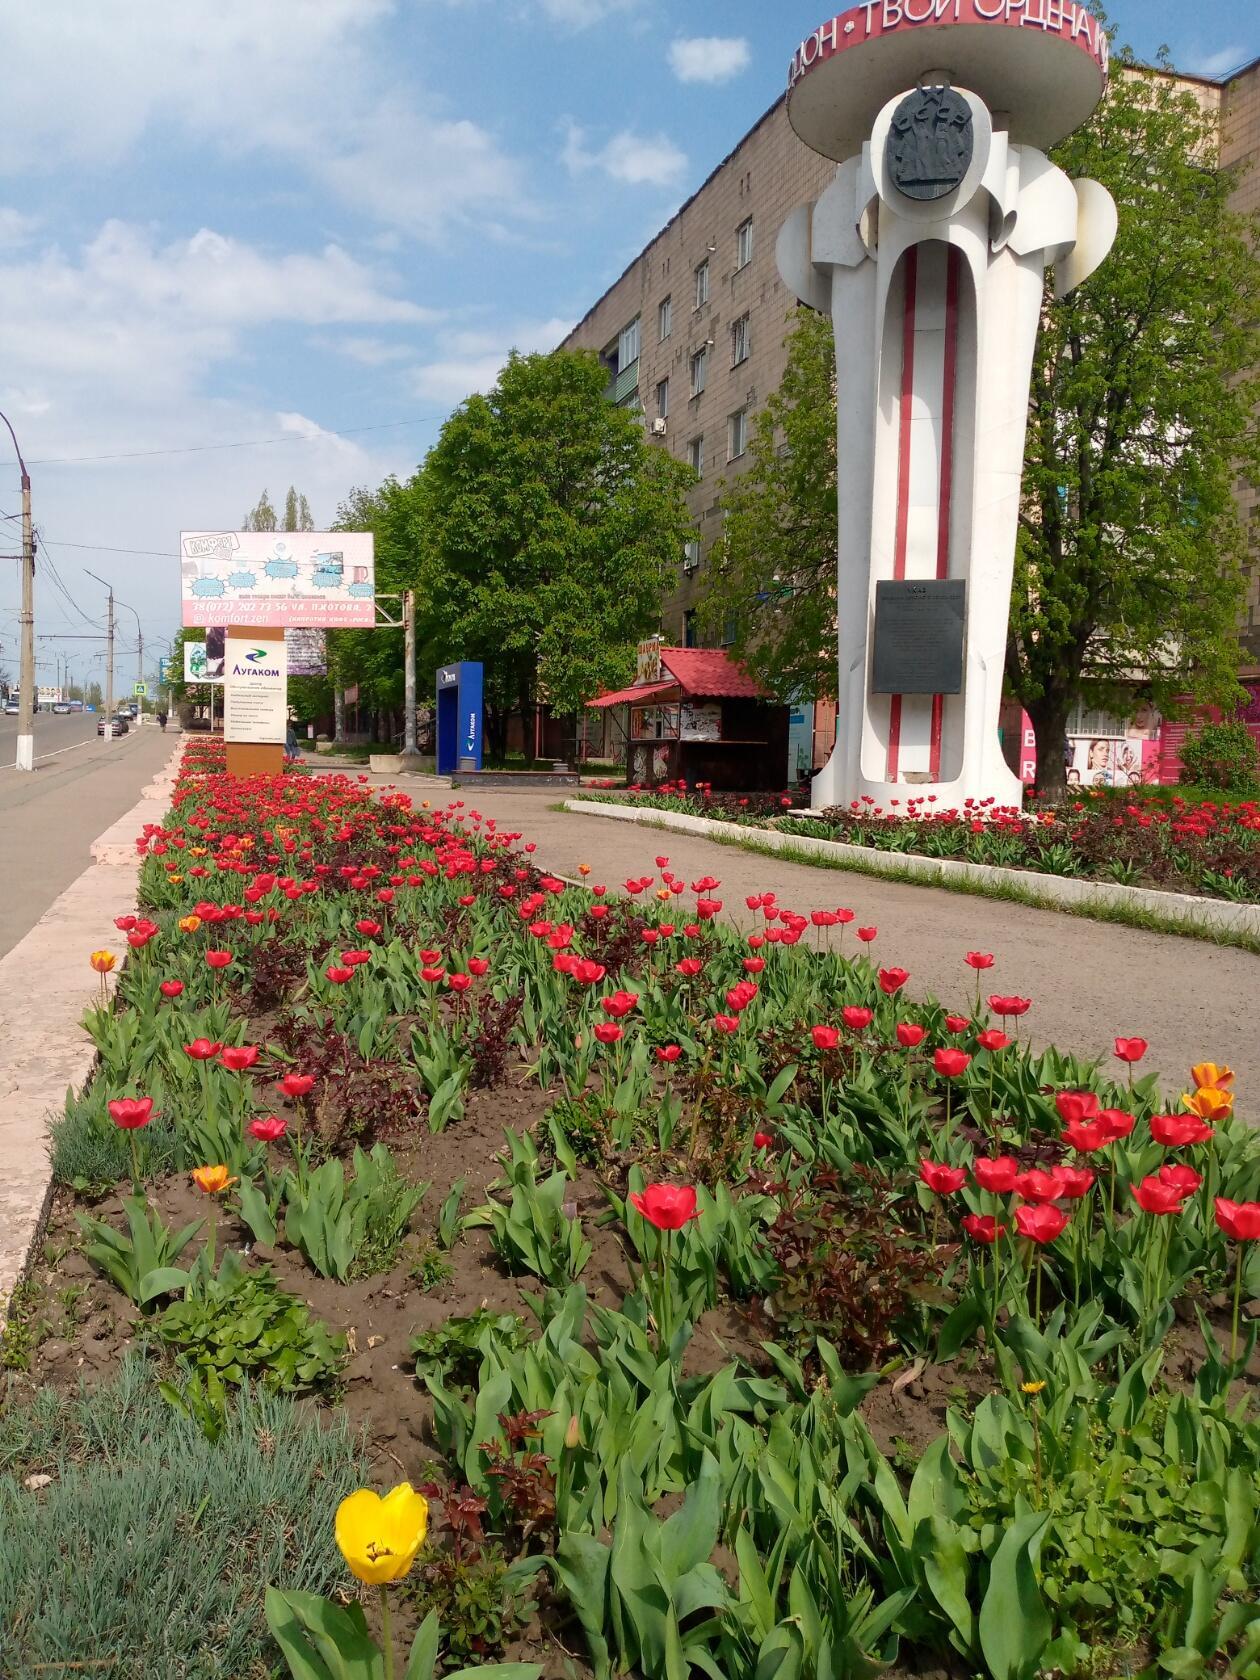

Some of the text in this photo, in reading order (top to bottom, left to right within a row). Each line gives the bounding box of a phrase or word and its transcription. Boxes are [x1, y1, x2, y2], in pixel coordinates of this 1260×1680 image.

[973, 0, 1092, 46] ОРДЕНА
[238, 602, 256, 611] 202
[275, 602, 288, 611] 56
